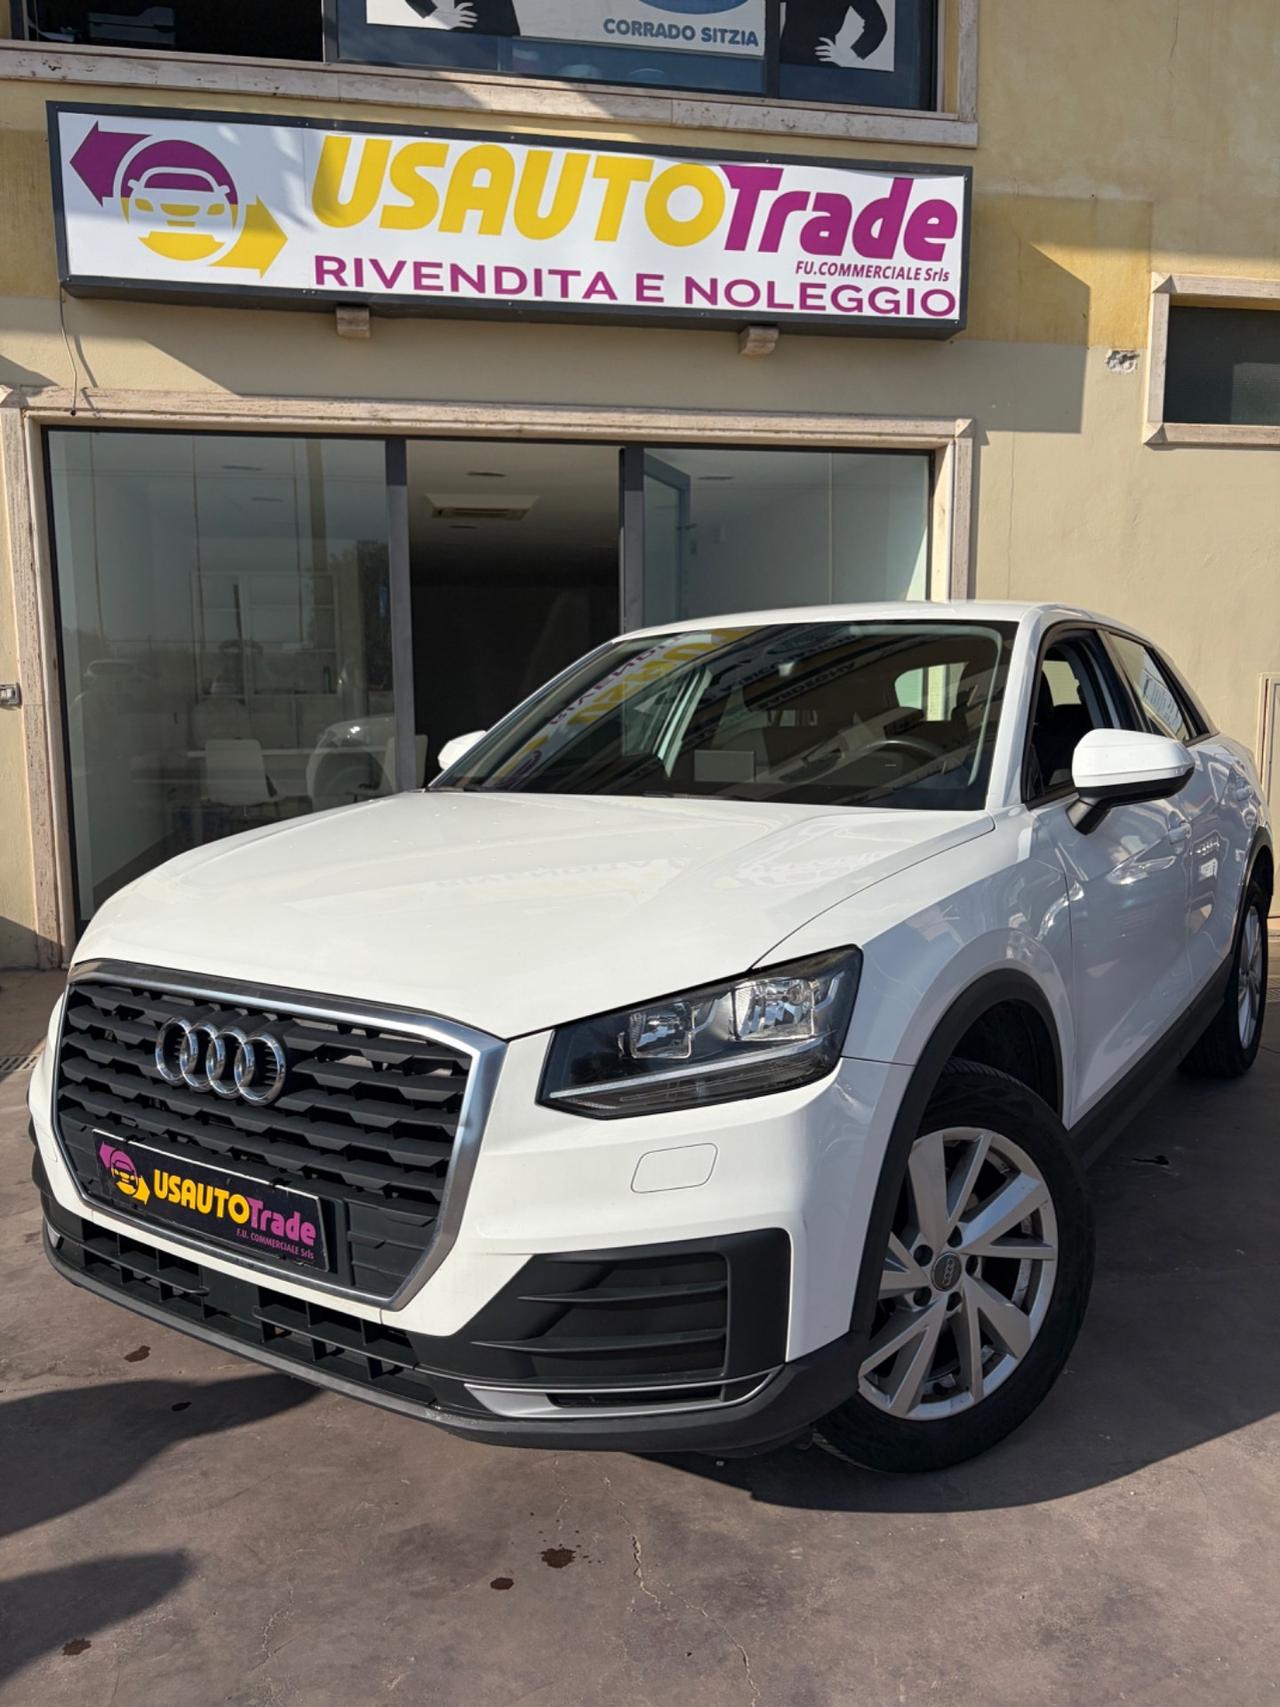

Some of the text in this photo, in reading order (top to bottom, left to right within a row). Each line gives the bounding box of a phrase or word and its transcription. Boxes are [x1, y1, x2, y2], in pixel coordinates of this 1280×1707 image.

[603, 18, 759, 47] CORRADO SITZIA
[314, 255, 956, 317] RIVENDITA E NOLEGGIO
[924, 266, 950, 282] Srls
[250, 1232, 300, 1255] COMMERCIALE
[301, 1246, 315, 1260] Srls
